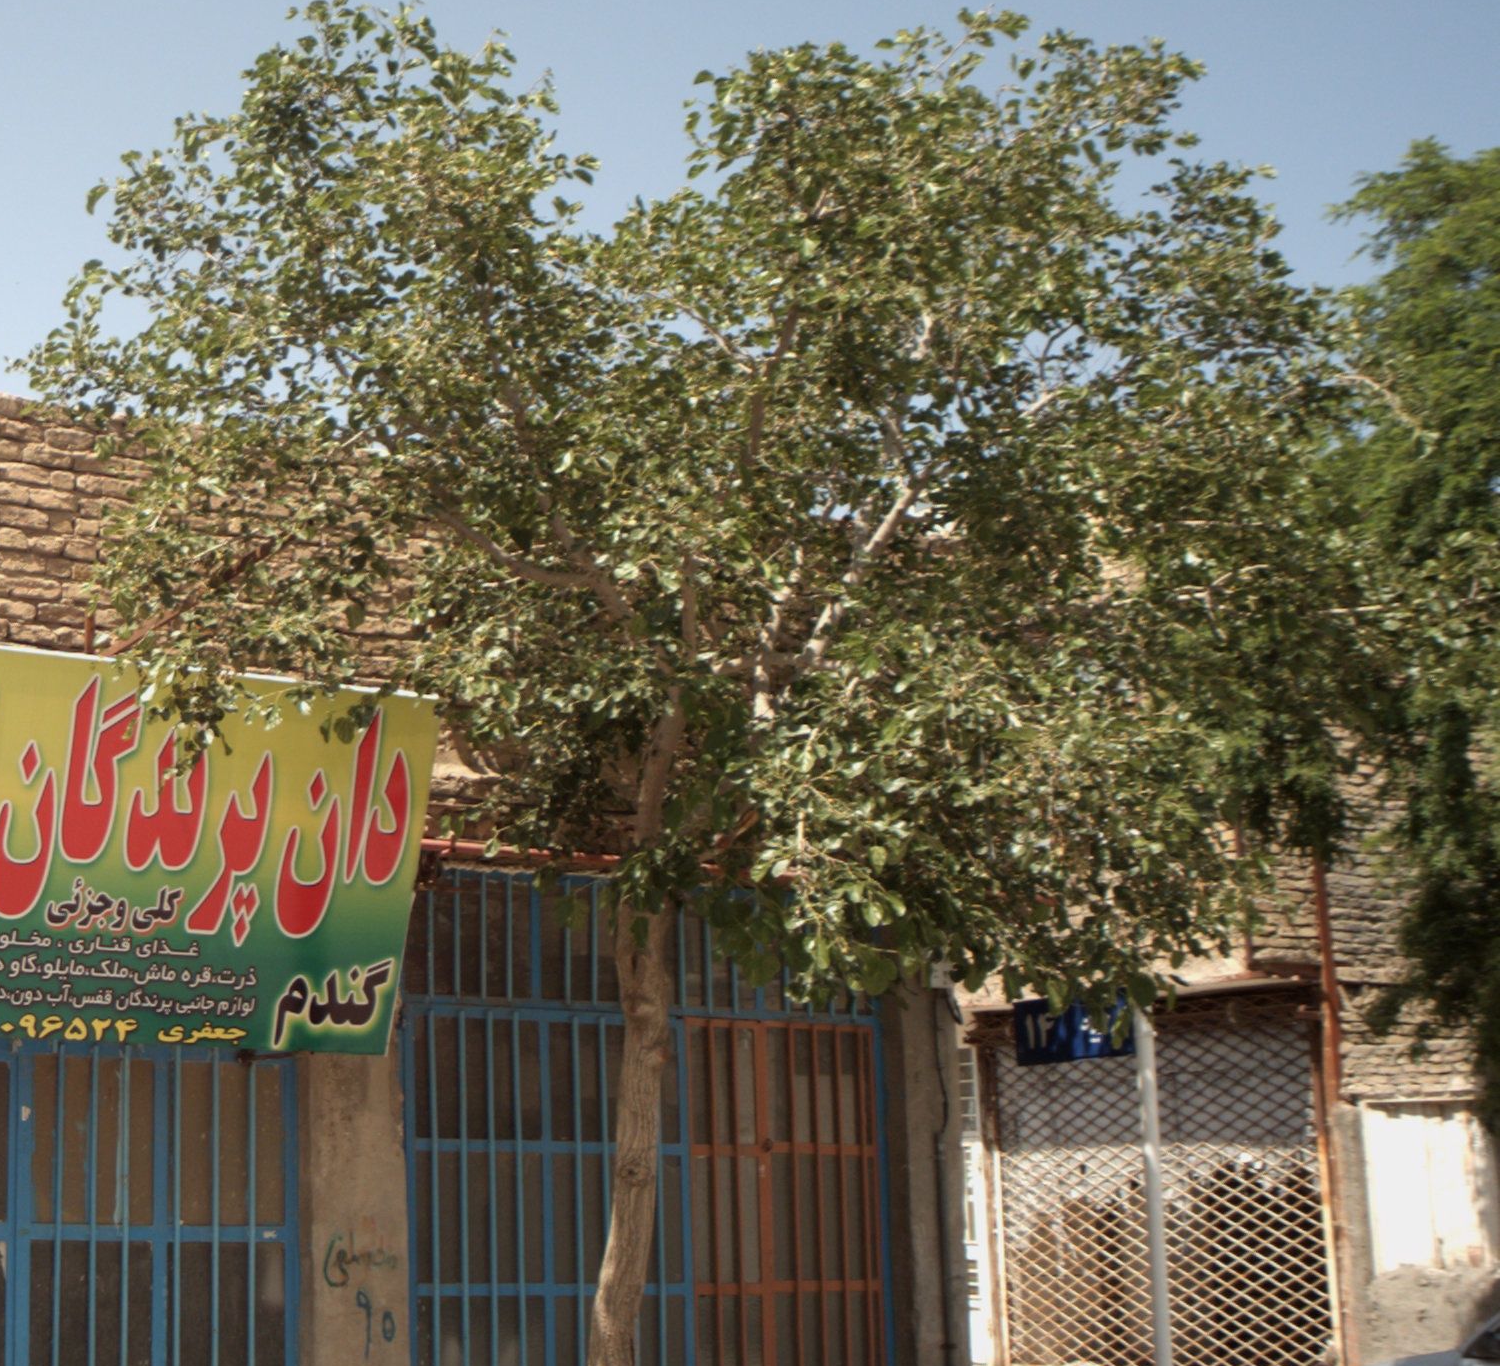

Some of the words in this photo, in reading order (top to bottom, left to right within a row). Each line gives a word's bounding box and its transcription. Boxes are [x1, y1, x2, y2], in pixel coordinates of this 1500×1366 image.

[274, 705, 411, 939] دان
[131, 886, 185, 931] کلی
[68, 936, 131, 955] قناری
[116, 988, 173, 1015] پرندگان
[175, 994, 214, 1015] جانبی
[217, 996, 255, 1017] لوازم
[271, 957, 395, 1048] گندم
[157, 1022, 247, 1045] جعفری
